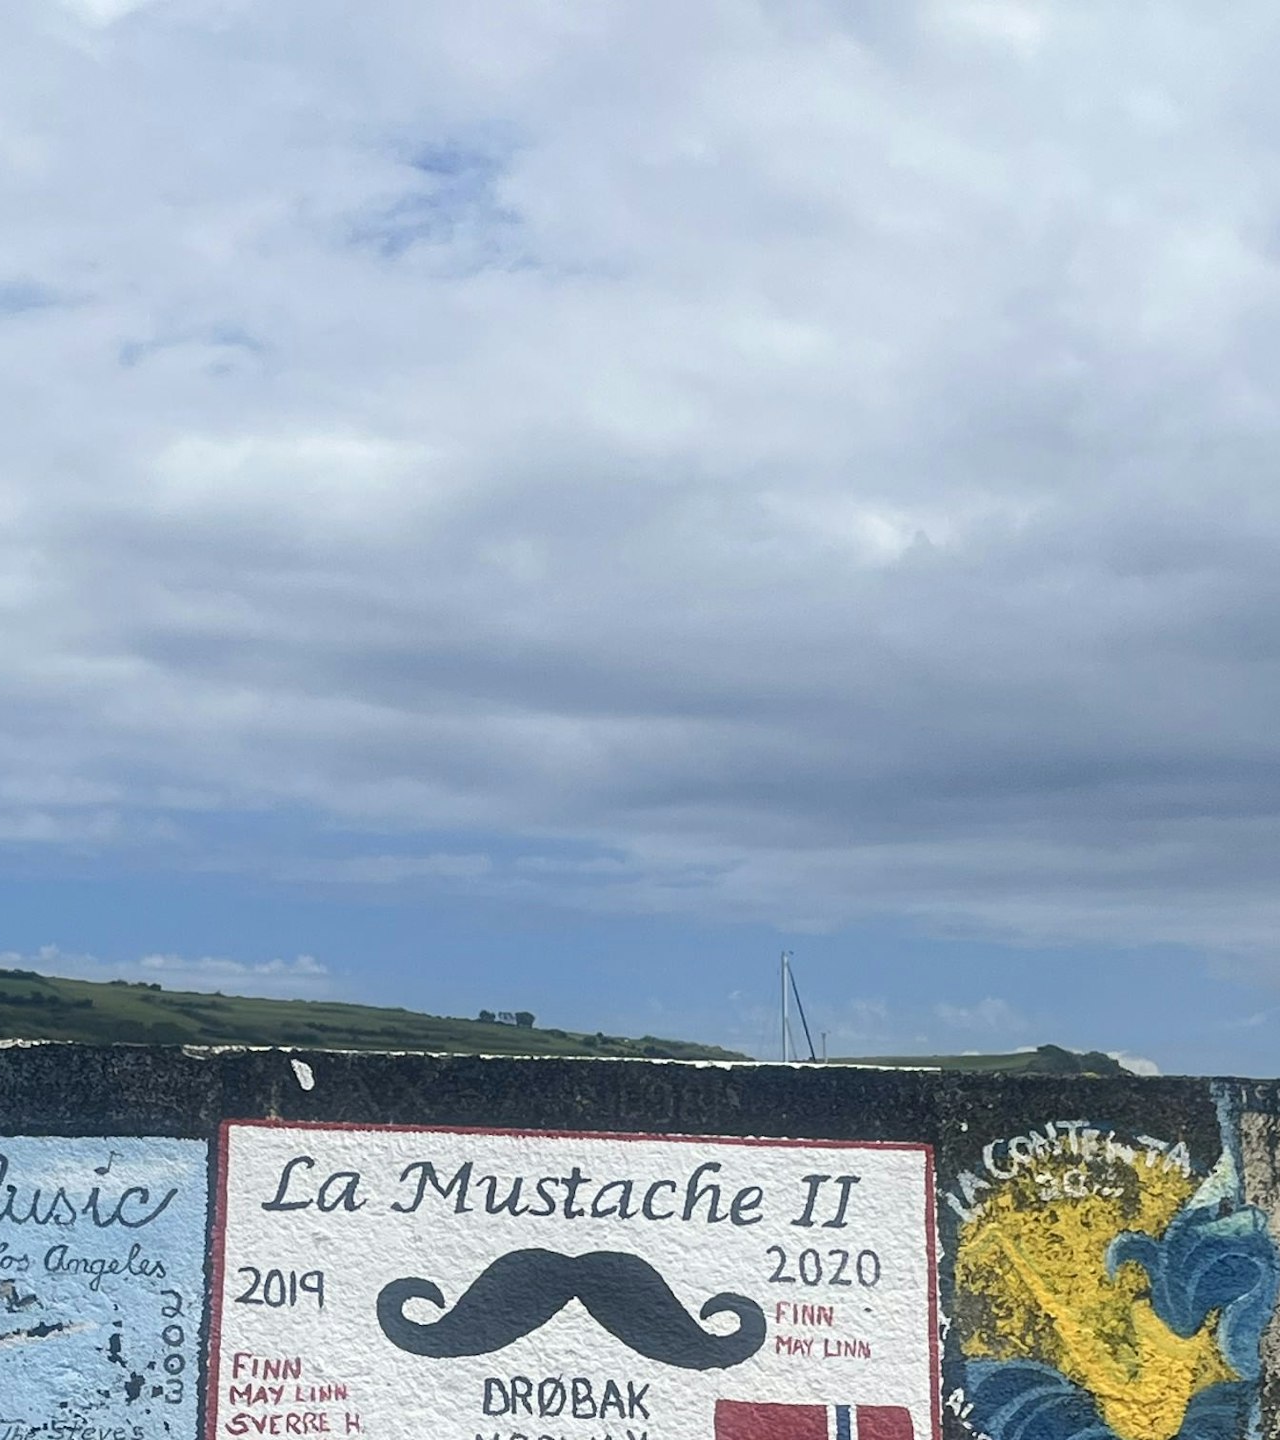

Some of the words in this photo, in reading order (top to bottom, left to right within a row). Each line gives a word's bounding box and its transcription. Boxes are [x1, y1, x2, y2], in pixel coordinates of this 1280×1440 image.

[261, 1155, 365, 1213] La
[391, 1161, 764, 1227] Mustache
[791, 1174, 861, 1229] II
[44, 1243, 168, 1291] Angeles
[235, 1266, 326, 1309] 2019
[766, 1245, 882, 1289] 2020
[775, 1301, 835, 1328] FINN
[160, 1290, 185, 1405] 2003
[232, 1353, 302, 1381] FINN
[774, 1336, 816, 1358] MAY
[823, 1337, 873, 1359] LINN
[229, 1384, 284, 1407] MAY
[295, 1384, 348, 1403] LINN
[481, 1376, 652, 1421] DRØBAK
[224, 1412, 331, 1436] SVERRE
